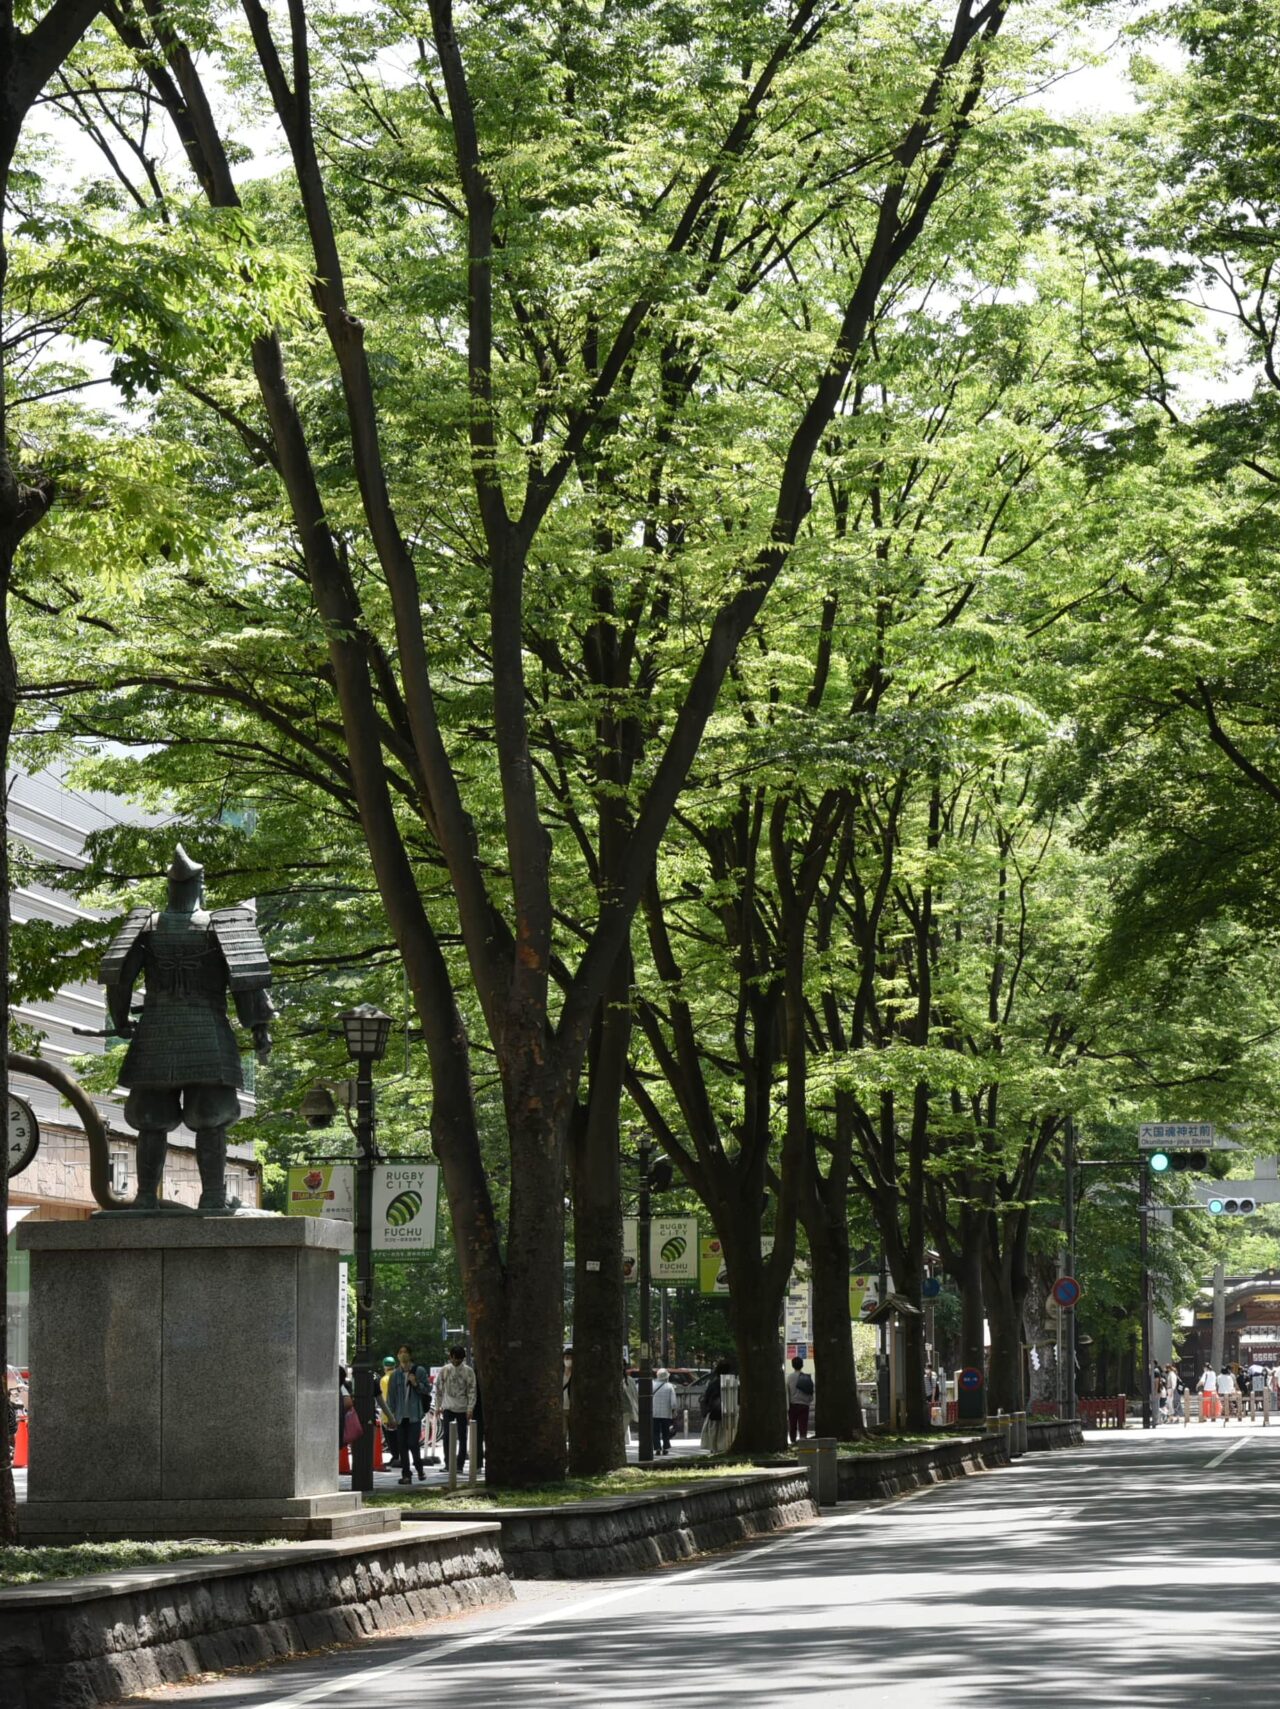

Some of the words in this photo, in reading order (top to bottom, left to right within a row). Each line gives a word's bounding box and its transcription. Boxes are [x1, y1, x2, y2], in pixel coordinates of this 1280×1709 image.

[10, 1111, 20, 1121] 2
[16, 1128, 26, 1137] 3
[1142, 1126, 1211, 1137] 大国魂神社前
[11, 1143, 21, 1152] 4
[386, 1172, 424, 1180] RUGBY
[386, 1181, 424, 1189] CITY
[384, 1228, 422, 1236] FUCHU
